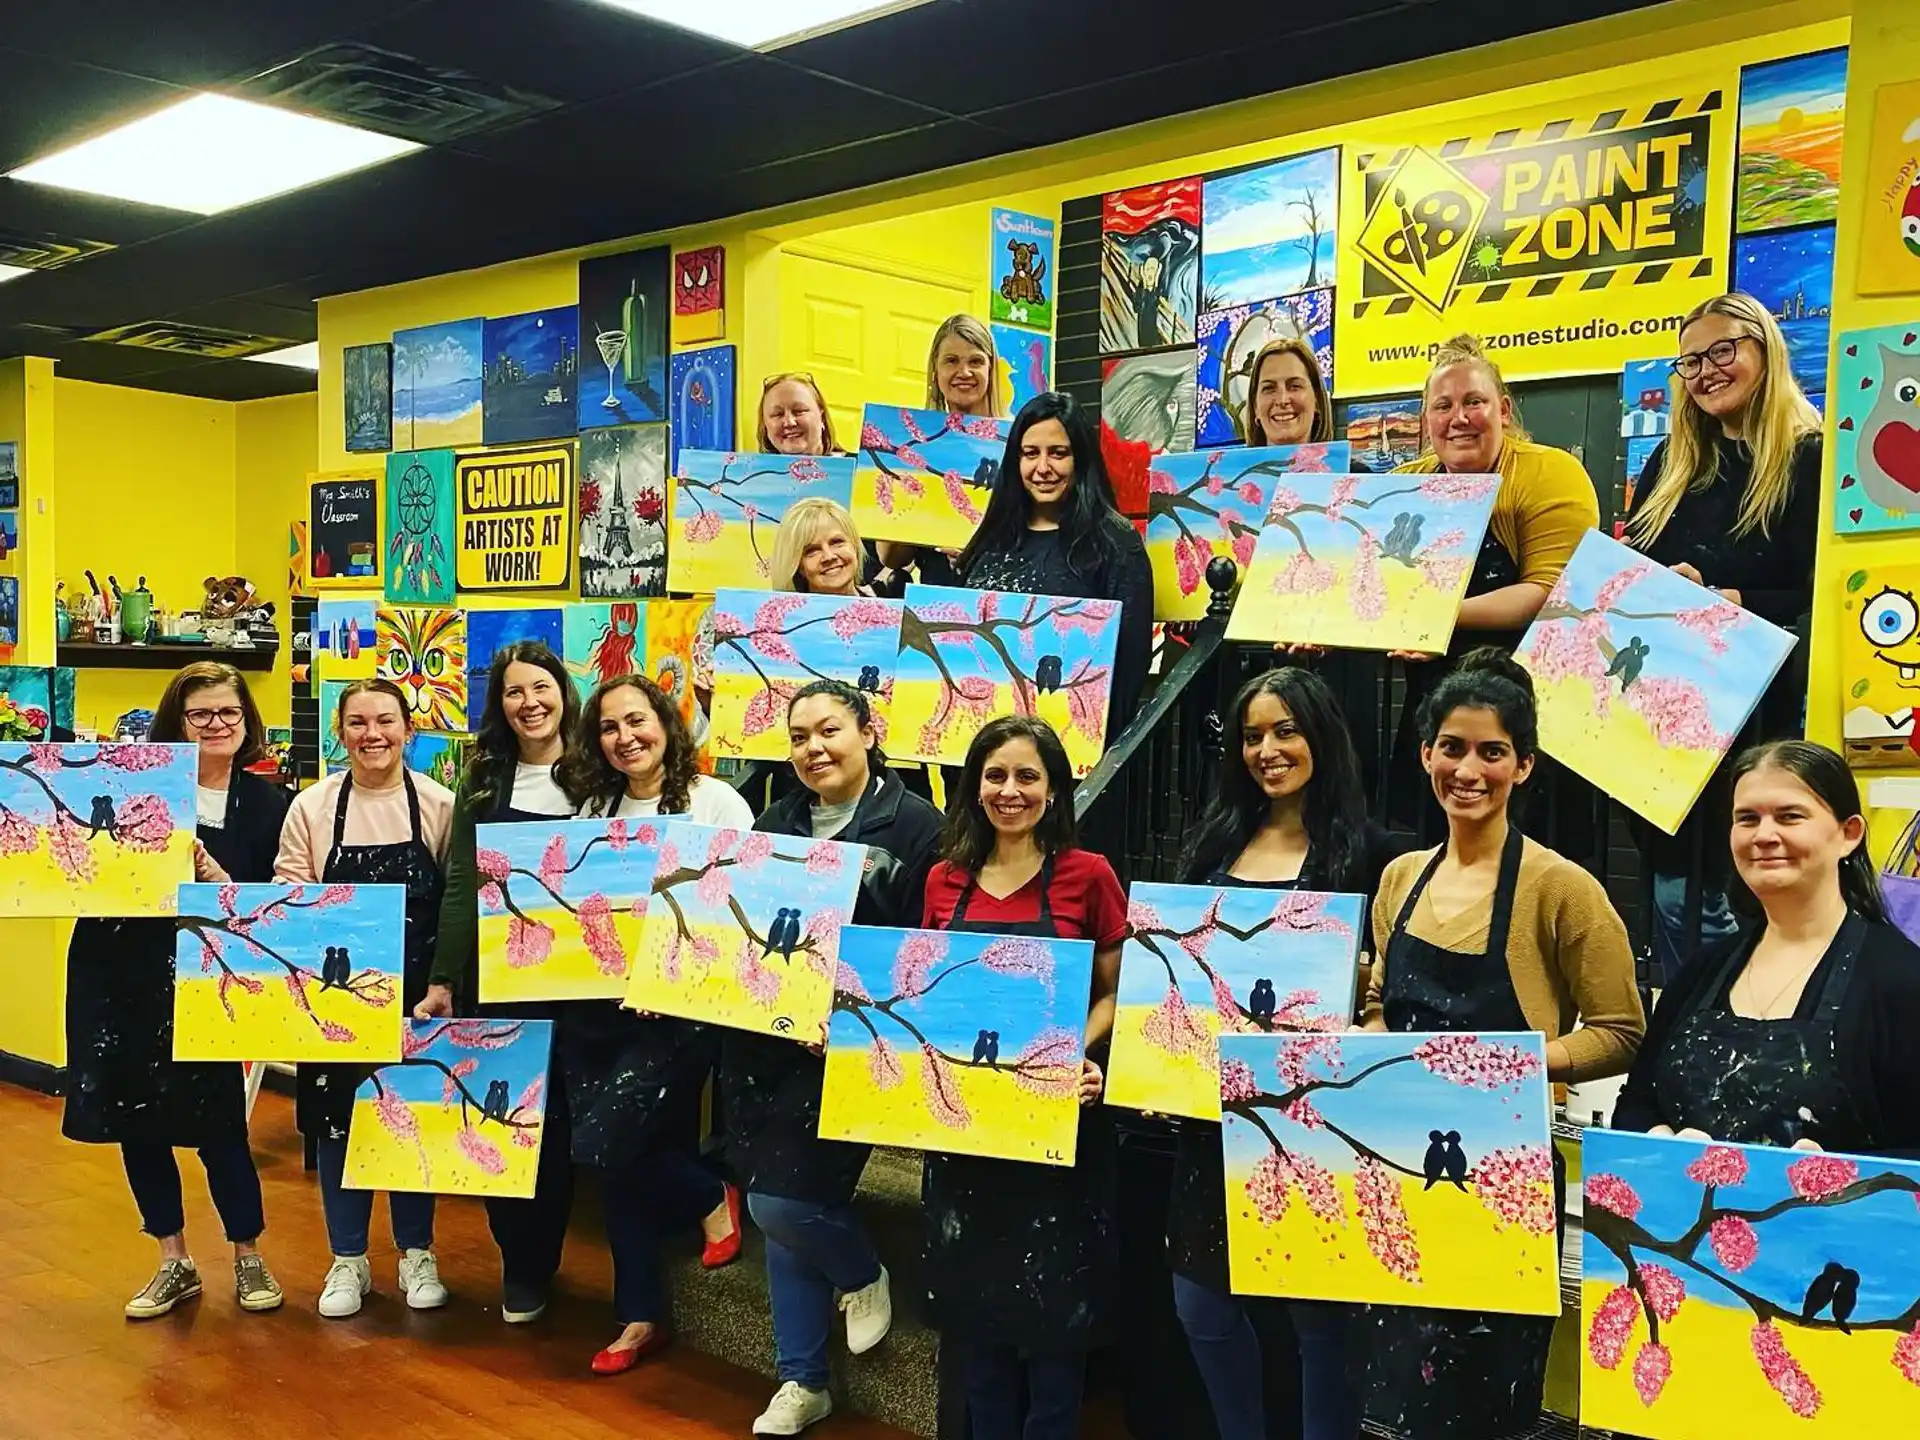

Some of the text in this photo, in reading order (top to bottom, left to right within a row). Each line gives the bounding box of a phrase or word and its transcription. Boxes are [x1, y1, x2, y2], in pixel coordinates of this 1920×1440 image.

[1503, 132, 1692, 212] PAINT
[1880, 157, 1918, 213] Happy
[1502, 193, 1676, 266] ZONE
[1368, 314, 1685, 362] www.pzonestudio.com
[467, 463, 560, 509] CAUTION
[464, 514, 562, 550] ARTISTS AT
[485, 551, 541, 582] WORK!
